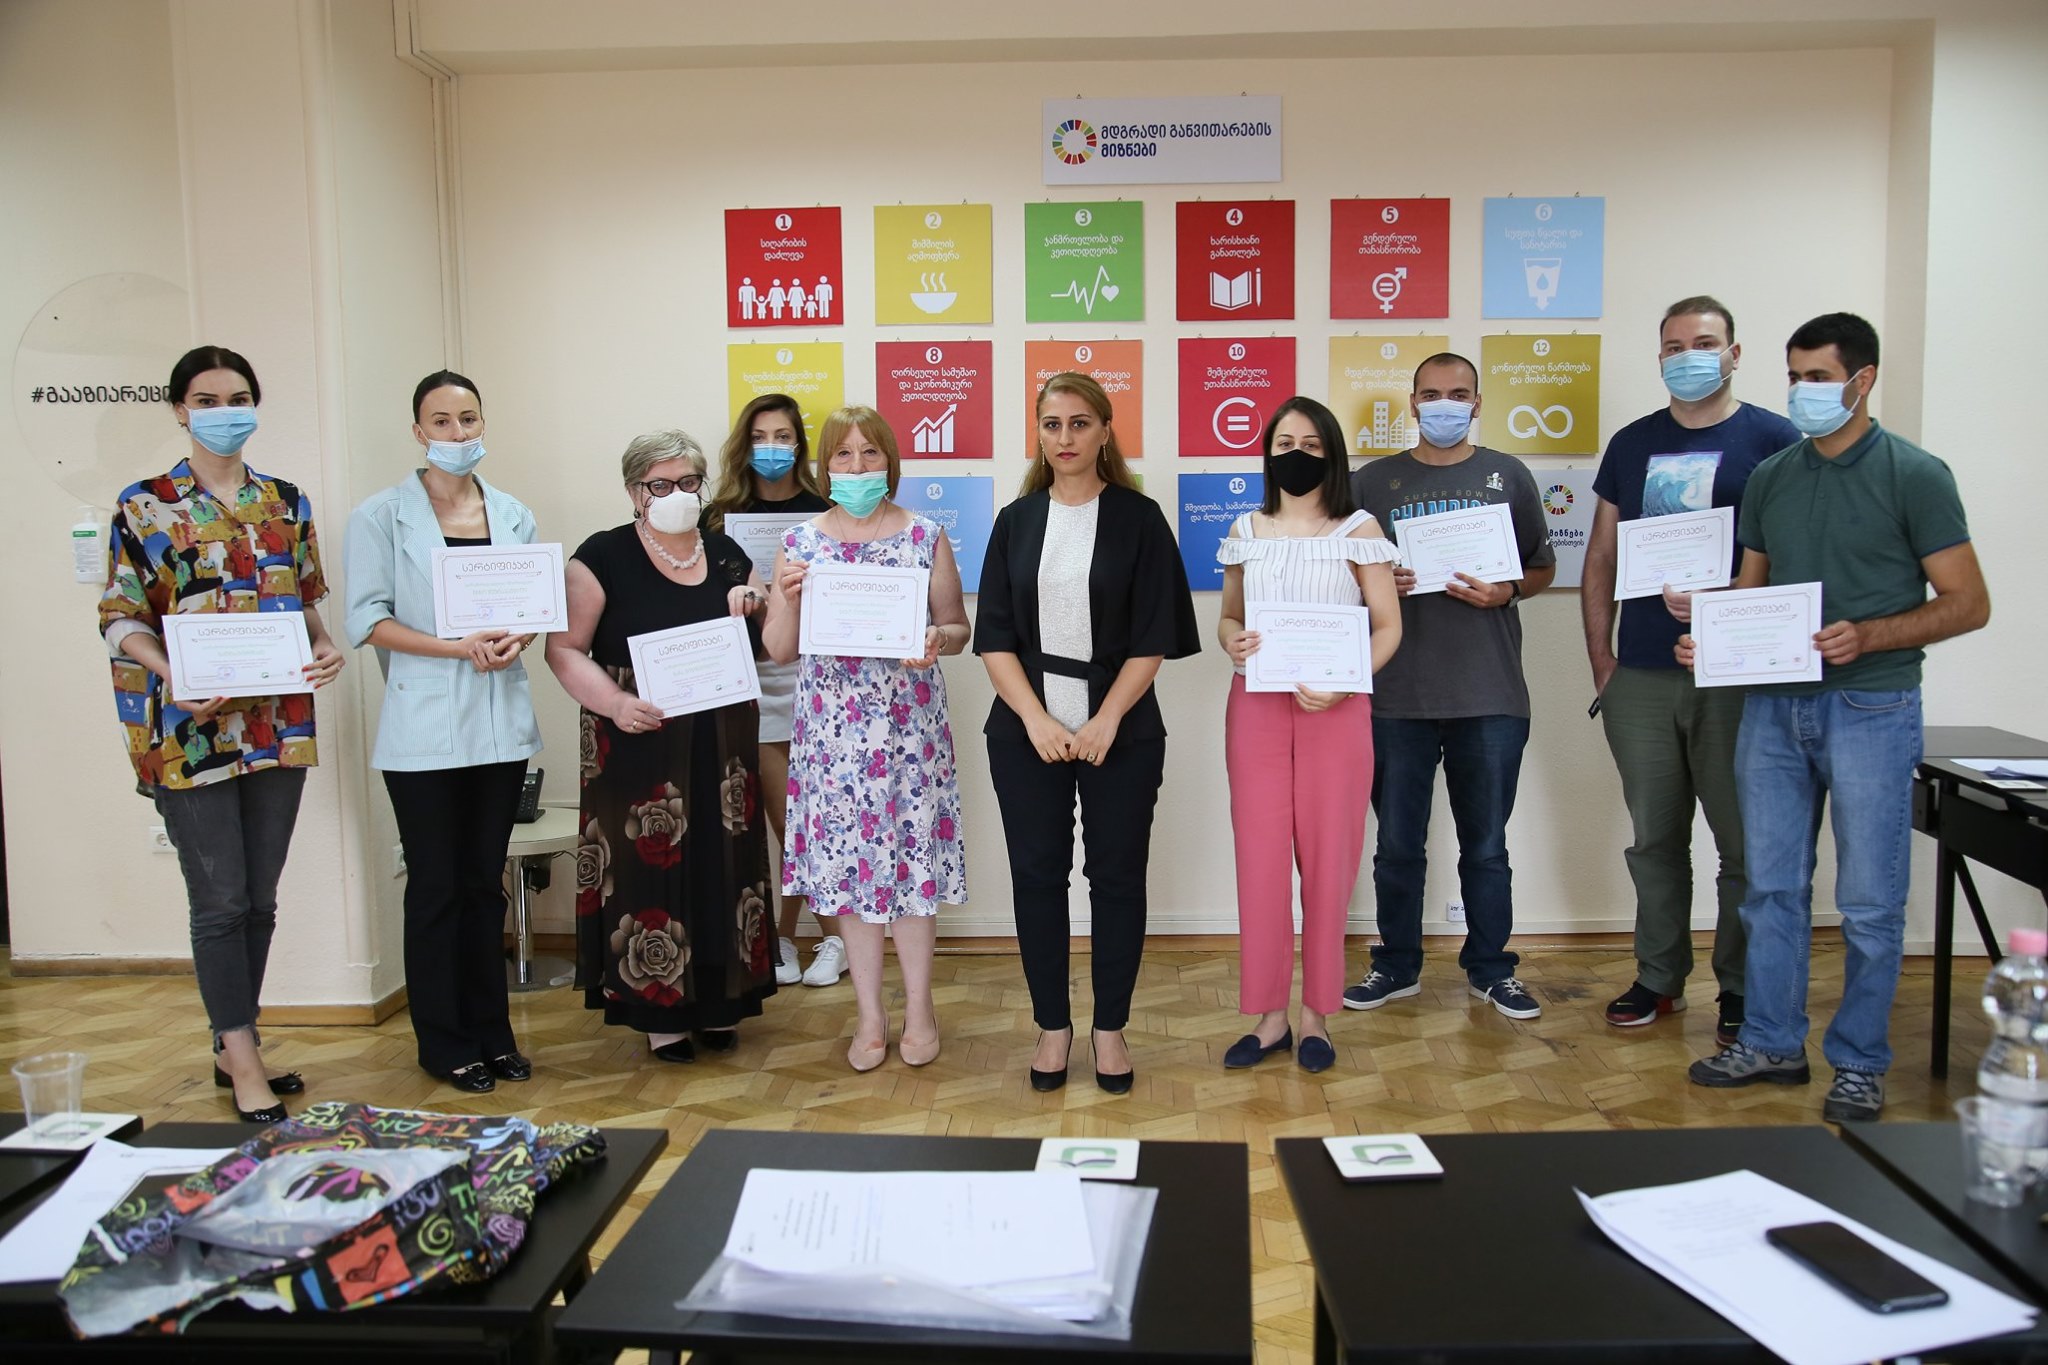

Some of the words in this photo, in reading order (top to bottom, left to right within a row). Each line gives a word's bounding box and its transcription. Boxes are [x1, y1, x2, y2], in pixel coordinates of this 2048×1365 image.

[1101, 124, 1167, 140] მდგრადი
[1170, 122, 1272, 138] განვითარების
[1101, 143, 1157, 158] მიზნები
[1079, 210, 1088, 224] 3
[1229, 210, 1239, 224] 4
[1385, 208, 1395, 222] 5
[1539, 205, 1549, 219] 6
[780, 215, 789, 229] 1
[928, 214, 938, 227] 2
[760, 237, 807, 249] სიღარიბის
[912, 238, 954, 250] შიმშილის
[1044, 234, 1108, 247] ჯანმრთელობა
[1111, 235, 1123, 245] და
[1210, 235, 1260, 246] ხარისხიანი
[1362, 233, 1417, 245] გენდერული
[1050, 246, 1117, 259] კეთილდღეობა
[1210, 248, 1260, 260] განათლება
[1358, 244, 1421, 255] თანასწორობა
[764, 251, 804, 262] დაძლევა
[1231, 346, 1243, 357] 10
[1383, 346, 1395, 357] 11
[1535, 342, 1548, 353] 12
[929, 349, 939, 362] 8
[1079, 347, 1088, 361] 9
[891, 367, 939, 378] ღირსეული
[941, 367, 976, 378] სამუშაო
[1207, 367, 1268, 378] შემცირებული
[1491, 363, 1545, 374] გონივრული
[1090, 369, 1131, 381] ინოვაცია
[1510, 375, 1523, 385] და
[1525, 374, 1572, 385] მოხმარება
[899, 380, 911, 390] და
[914, 379, 973, 390] ეკონომიკური
[1204, 379, 1271, 391] უთანასწორობა
[901, 391, 967, 402] კეთილდღეობა
[929, 486, 940, 496] 14
[1231, 480, 1244, 491] 16
[1404, 490, 1448, 502] SUPER
[1455, 489, 1491, 500] BOWL
[1190, 514, 1201, 523] და
[1203, 513, 1234, 522] ძლიერი
[748, 527, 788, 537] სერტიფ
